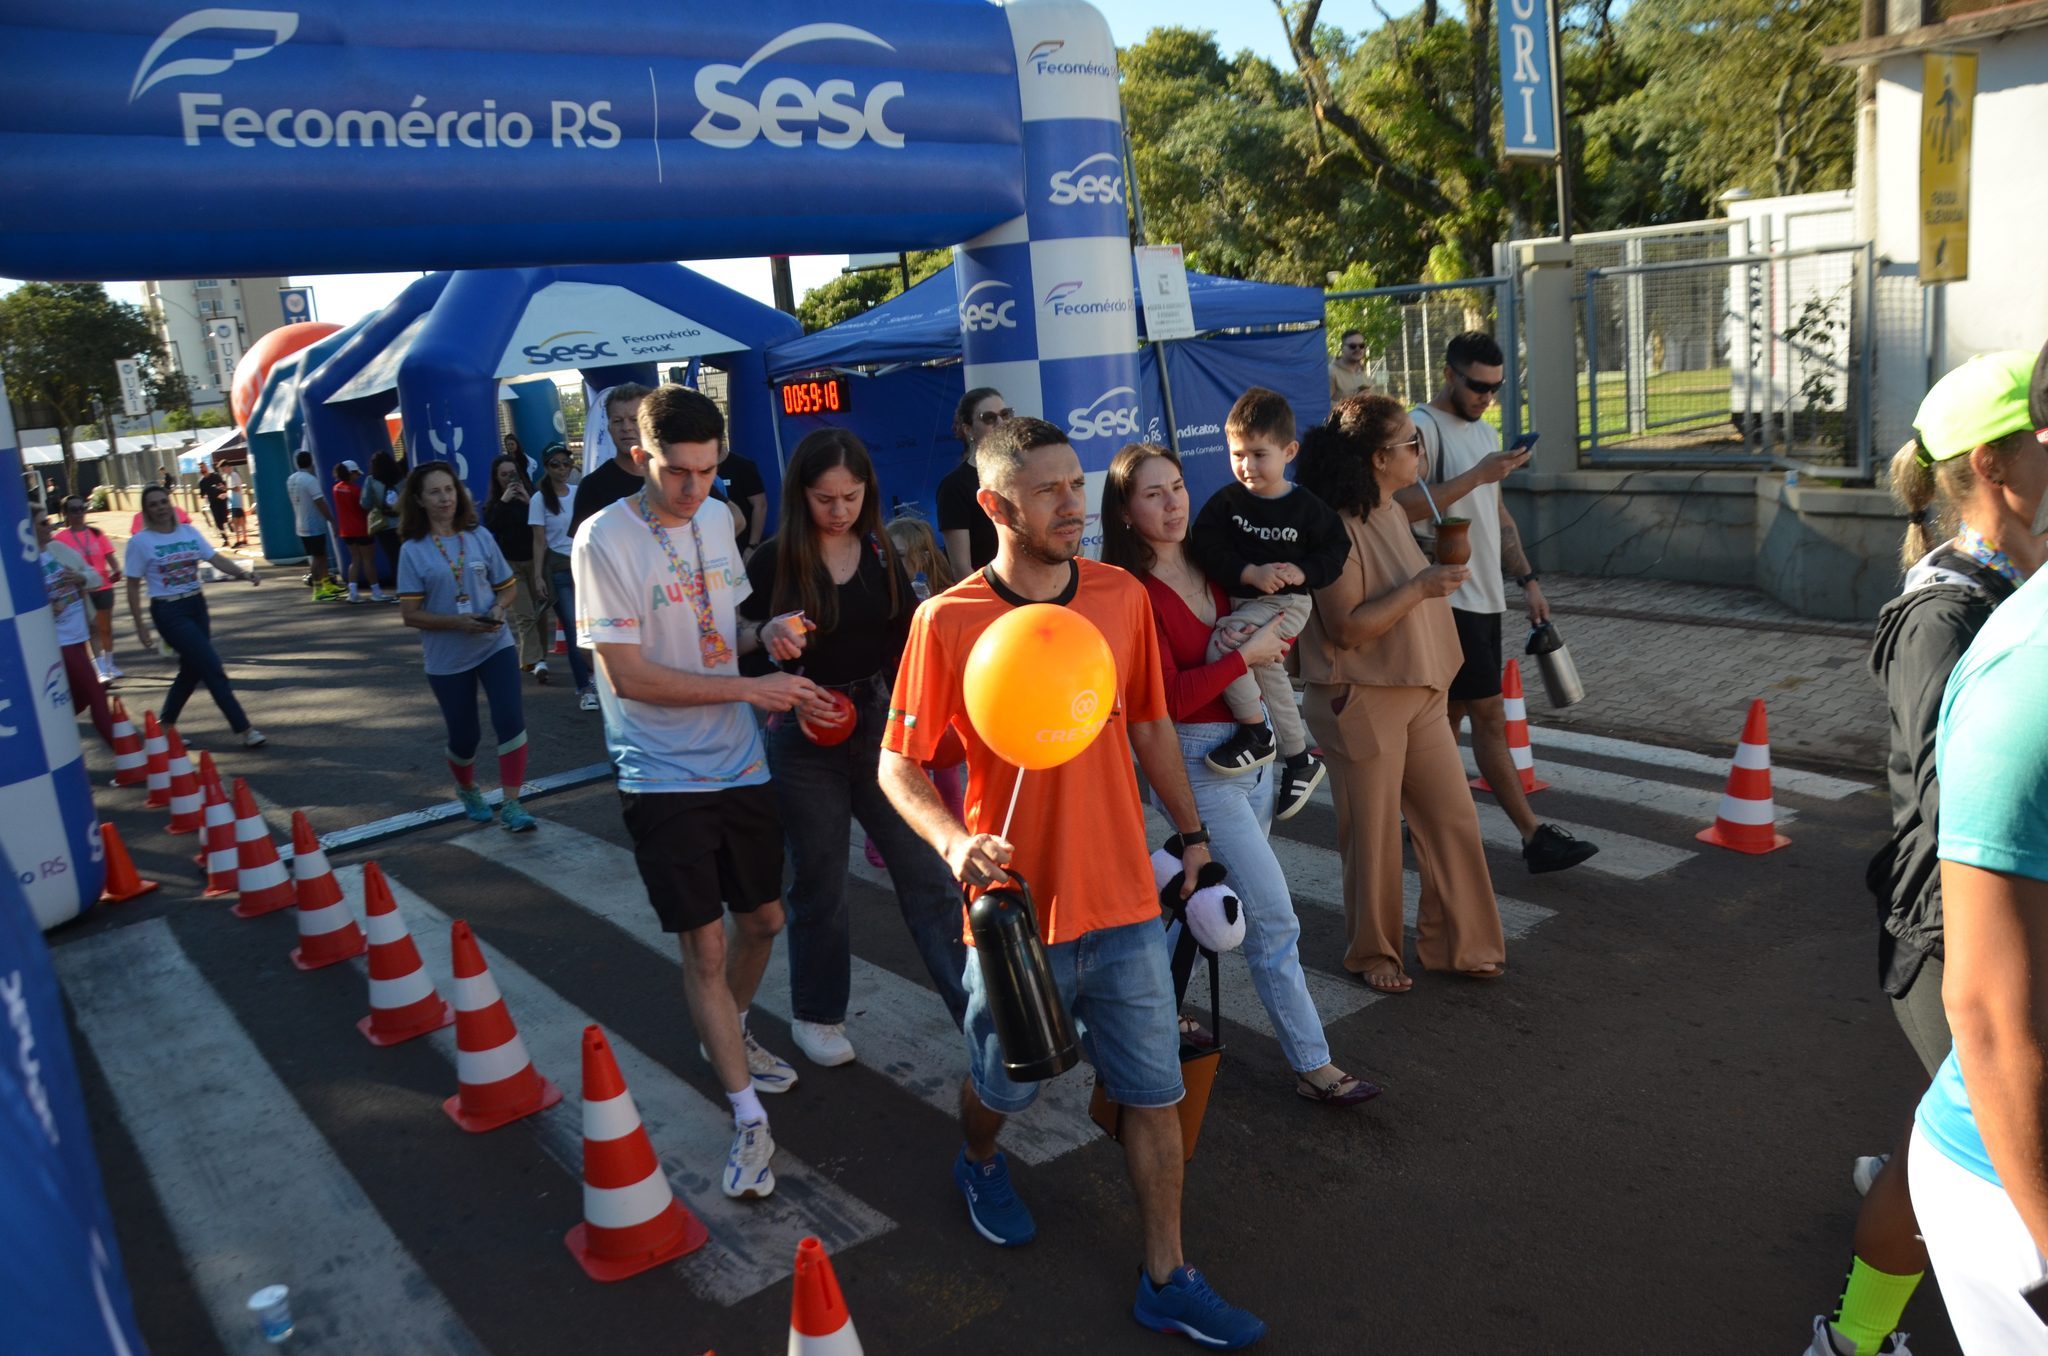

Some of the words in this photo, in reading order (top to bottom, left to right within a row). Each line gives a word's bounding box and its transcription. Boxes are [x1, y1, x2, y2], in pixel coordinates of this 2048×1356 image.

[1037, 60, 1110, 77] Fecomércio
[179, 92, 533, 149] Fecomércio
[551, 100, 621, 149] RS
[690, 63, 905, 150] Sesc
[1054, 299, 1127, 316] Fecomércio
[622, 328, 701, 345] Fecomércio
[631, 342, 676, 355] Senac
[220, 342, 236, 376] UR
[522, 341, 618, 365] Sesc
[125, 377, 139, 412] URI
[783, 380, 839, 414] 00:59:18
[1067, 406, 1140, 441] Sesc
[1176, 423, 1221, 439] ndicatos
[652, 567, 733, 610] Ausmo
[40, 857, 68, 879] RS
